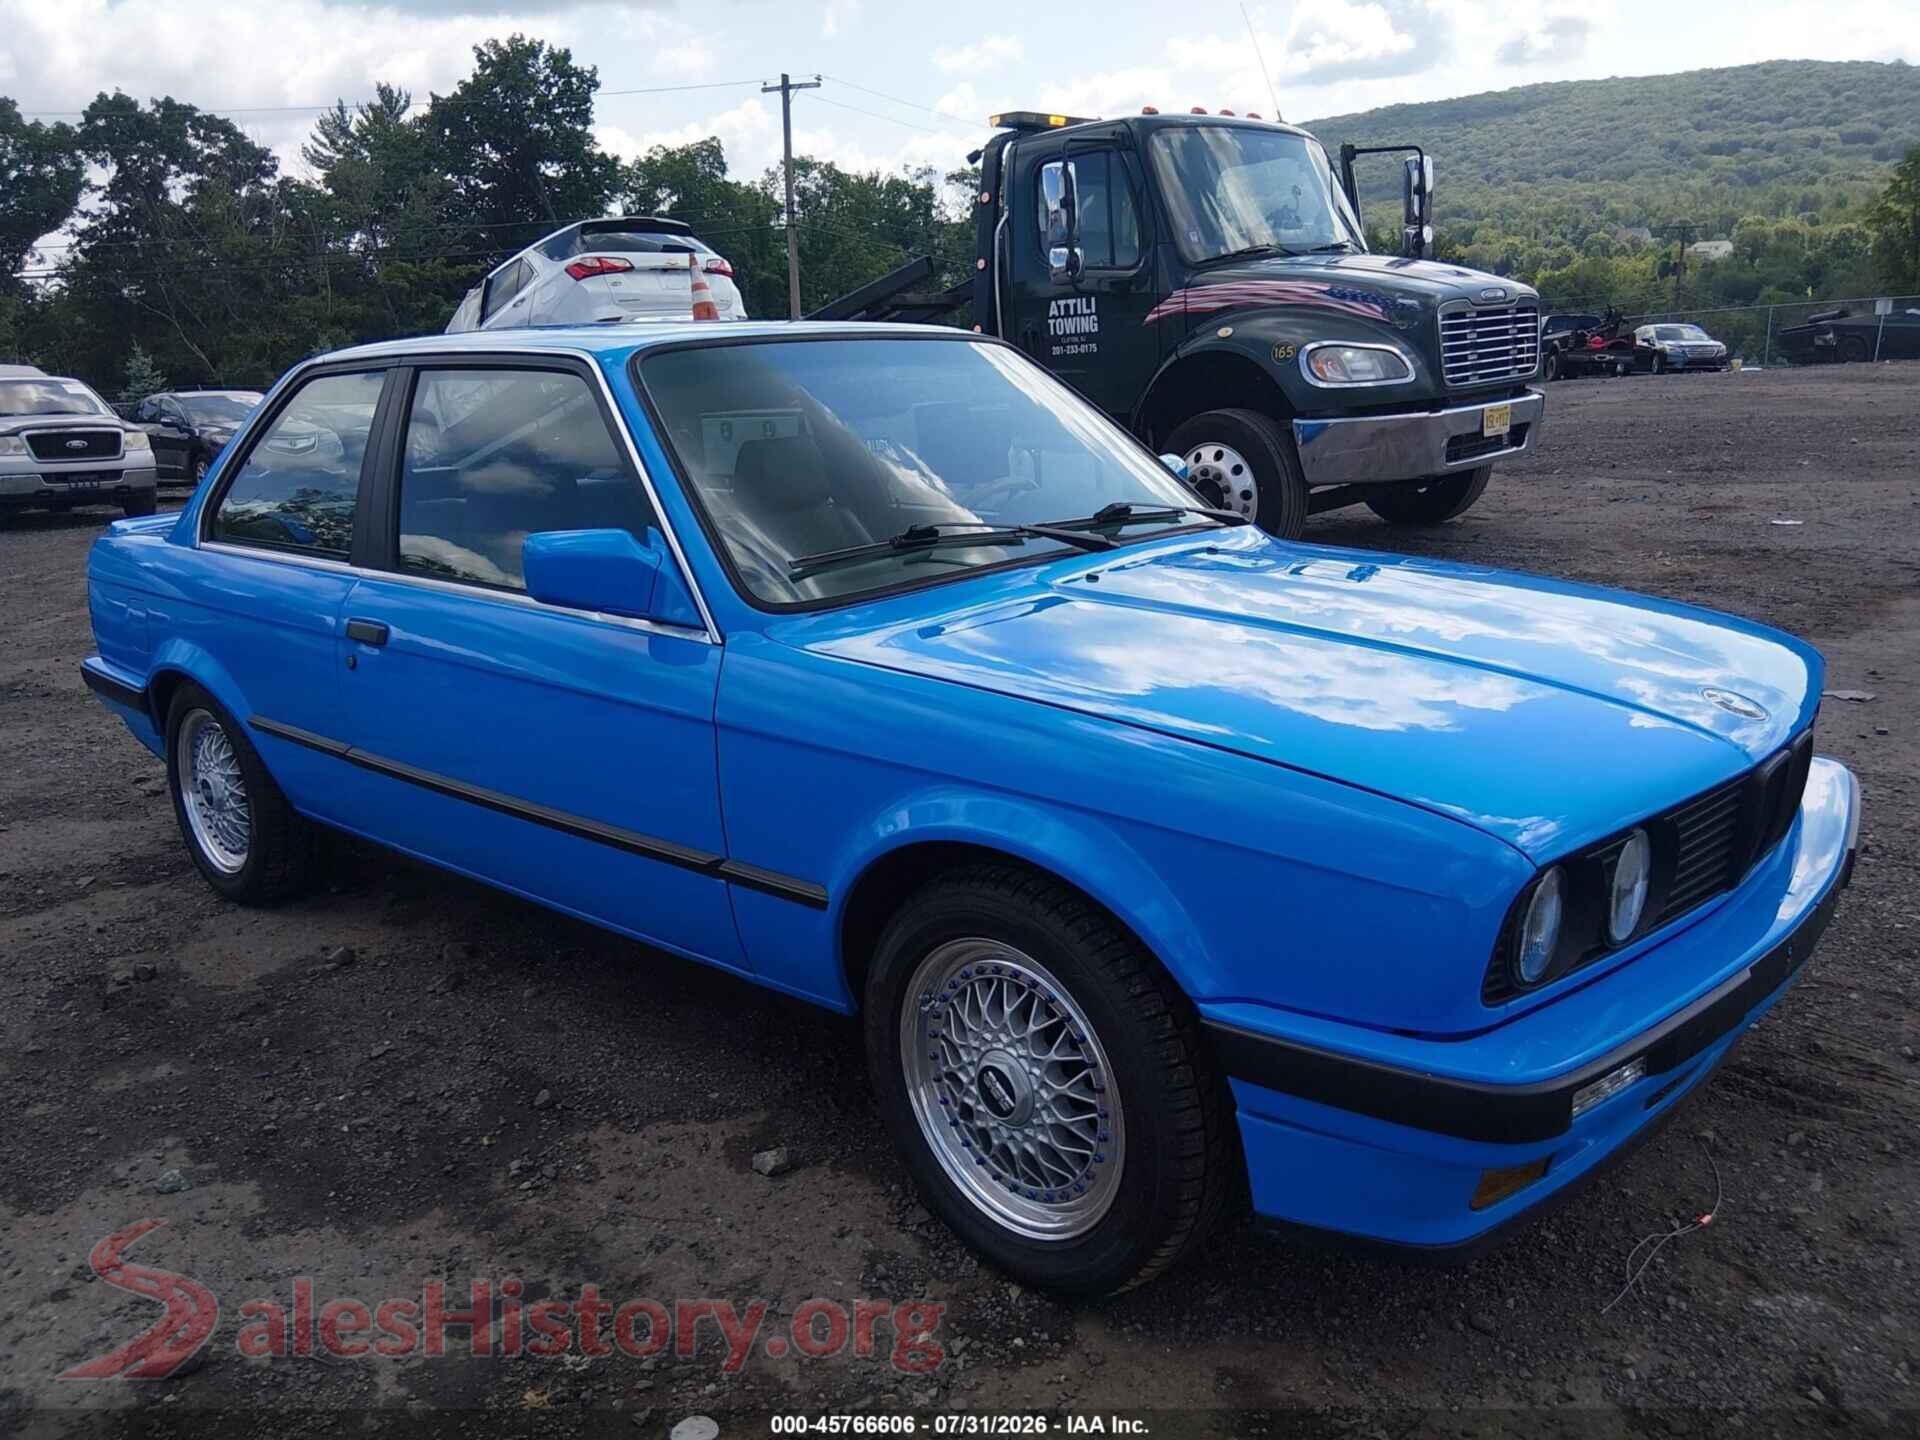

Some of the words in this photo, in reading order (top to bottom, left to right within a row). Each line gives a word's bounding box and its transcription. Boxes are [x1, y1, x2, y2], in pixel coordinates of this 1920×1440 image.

[1049, 297, 1096, 317] ATTILI
[1048, 315, 1098, 336] TOWING
[1275, 345, 1294, 359] 165
